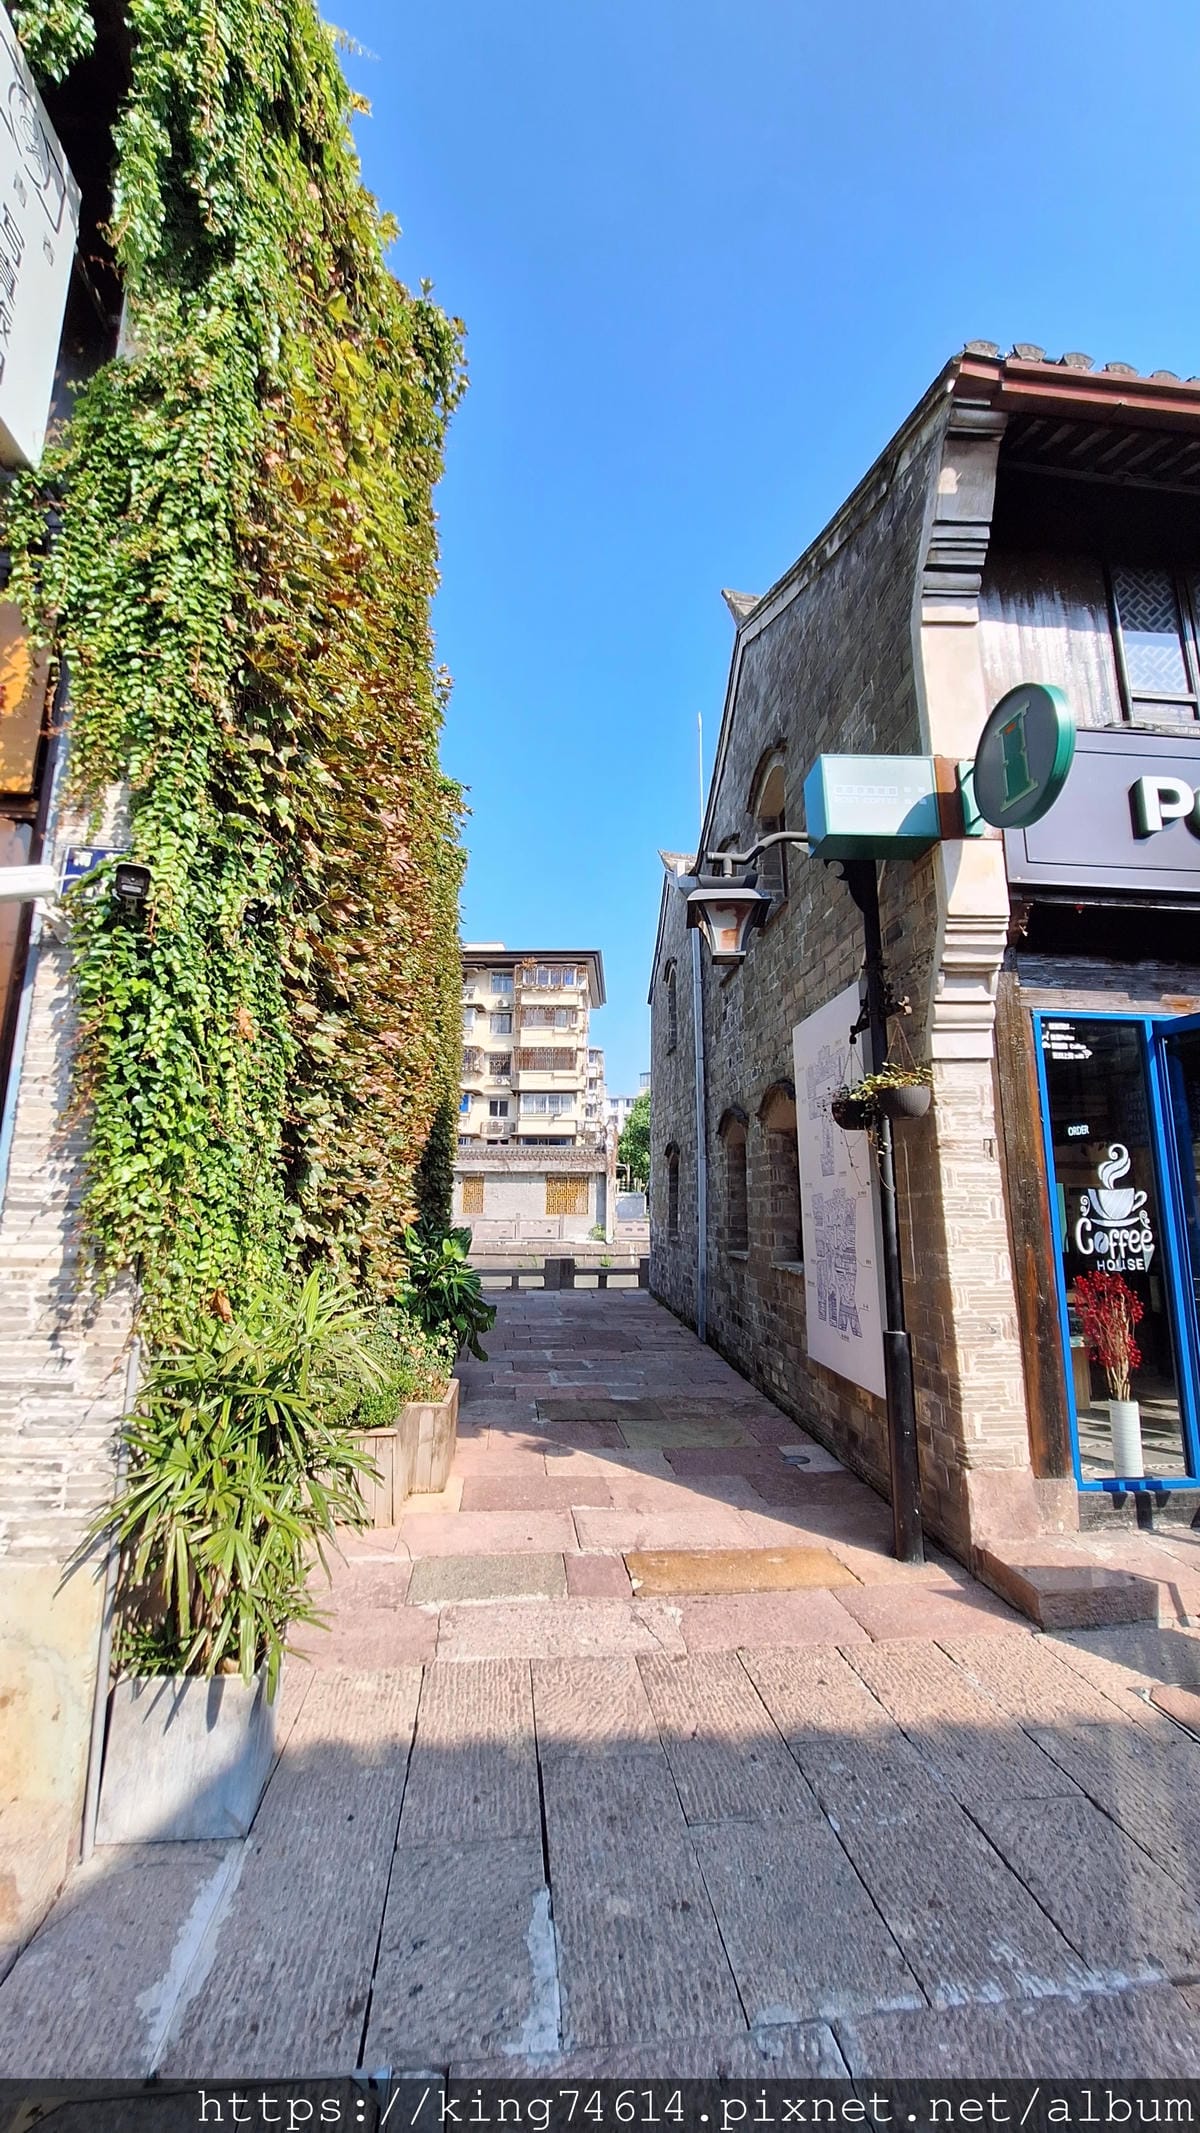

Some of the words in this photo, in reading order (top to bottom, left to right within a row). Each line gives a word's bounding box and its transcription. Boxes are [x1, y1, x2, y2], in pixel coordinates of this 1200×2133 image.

[1136, 775, 1200, 839] P
[1067, 1124, 1090, 1137] ORDER
[1075, 1217, 1155, 1260] Coffee
[1096, 1258, 1145, 1272] HOUSE
